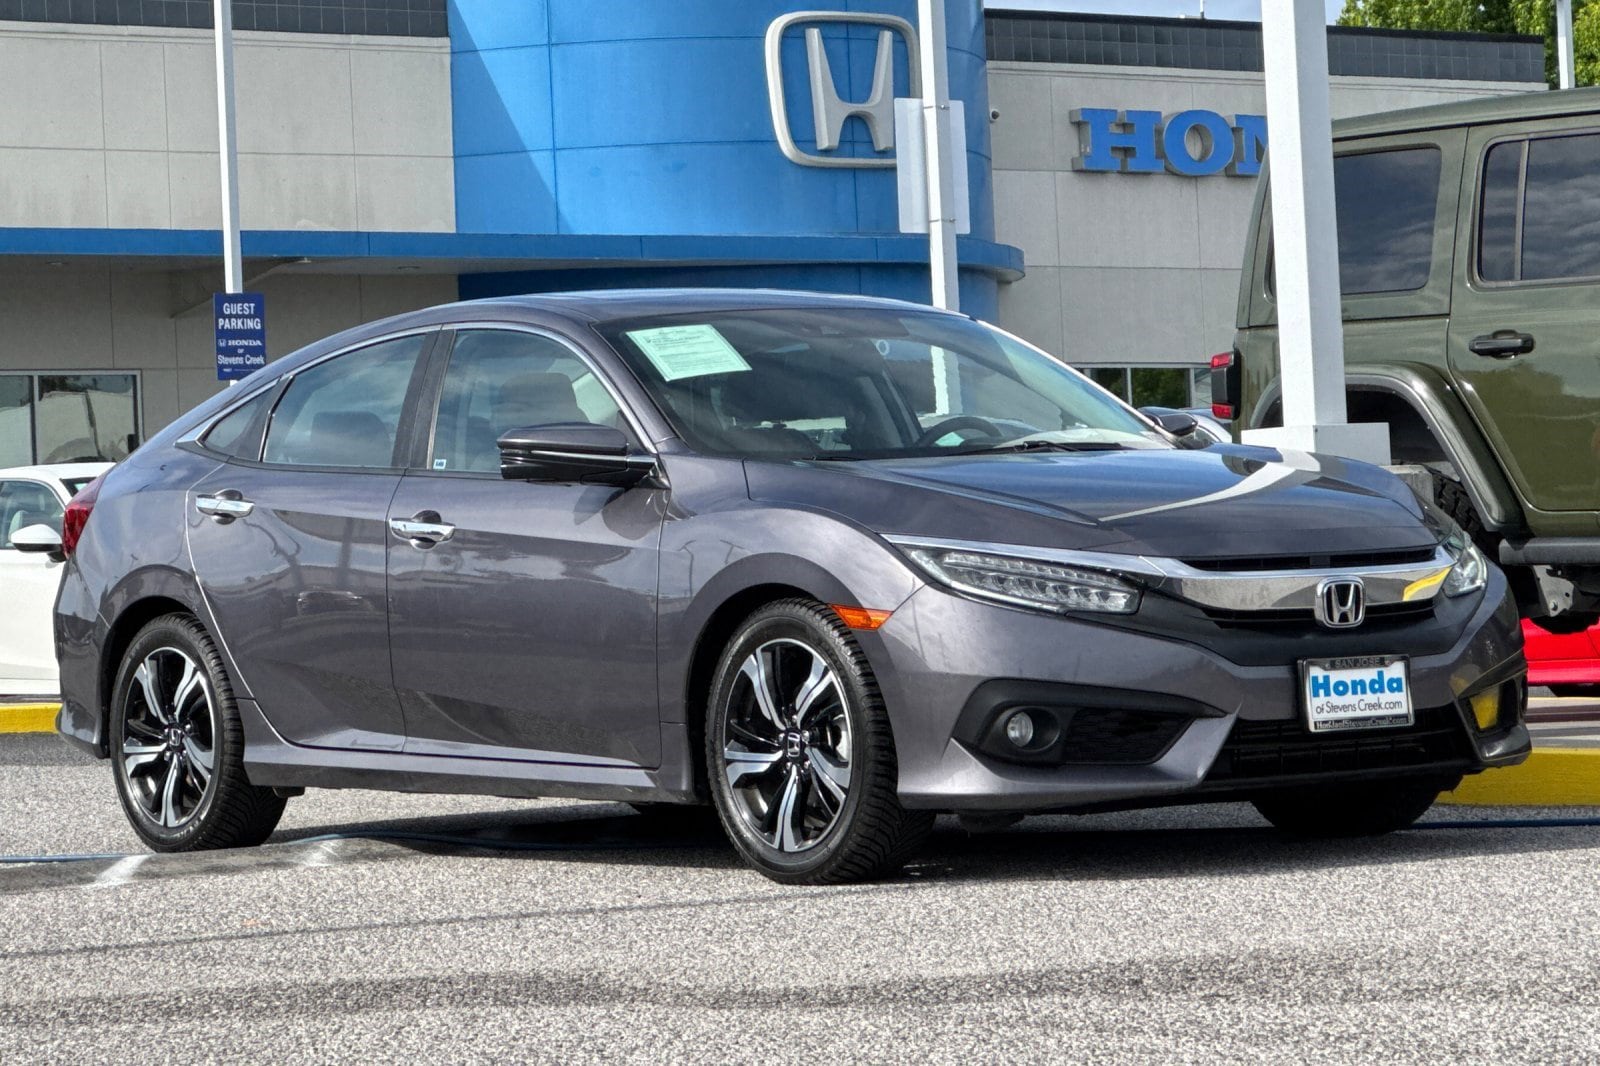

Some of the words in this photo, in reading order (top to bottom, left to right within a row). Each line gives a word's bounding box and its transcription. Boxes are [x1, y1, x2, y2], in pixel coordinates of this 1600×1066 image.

[223, 303, 255, 315] GUEST
[218, 318, 262, 330] PARKING
[217, 354, 244, 365] Stevens
[245, 354, 266, 365] Creek
[1335, 658, 1354, 668] SAN
[1356, 656, 1380, 667] JOSE
[1311, 670, 1404, 698] Honda
[1315, 703, 1325, 714] of
[1325, 700, 1357, 714] Stevens
[1357, 697, 1403, 712] Creek.com
